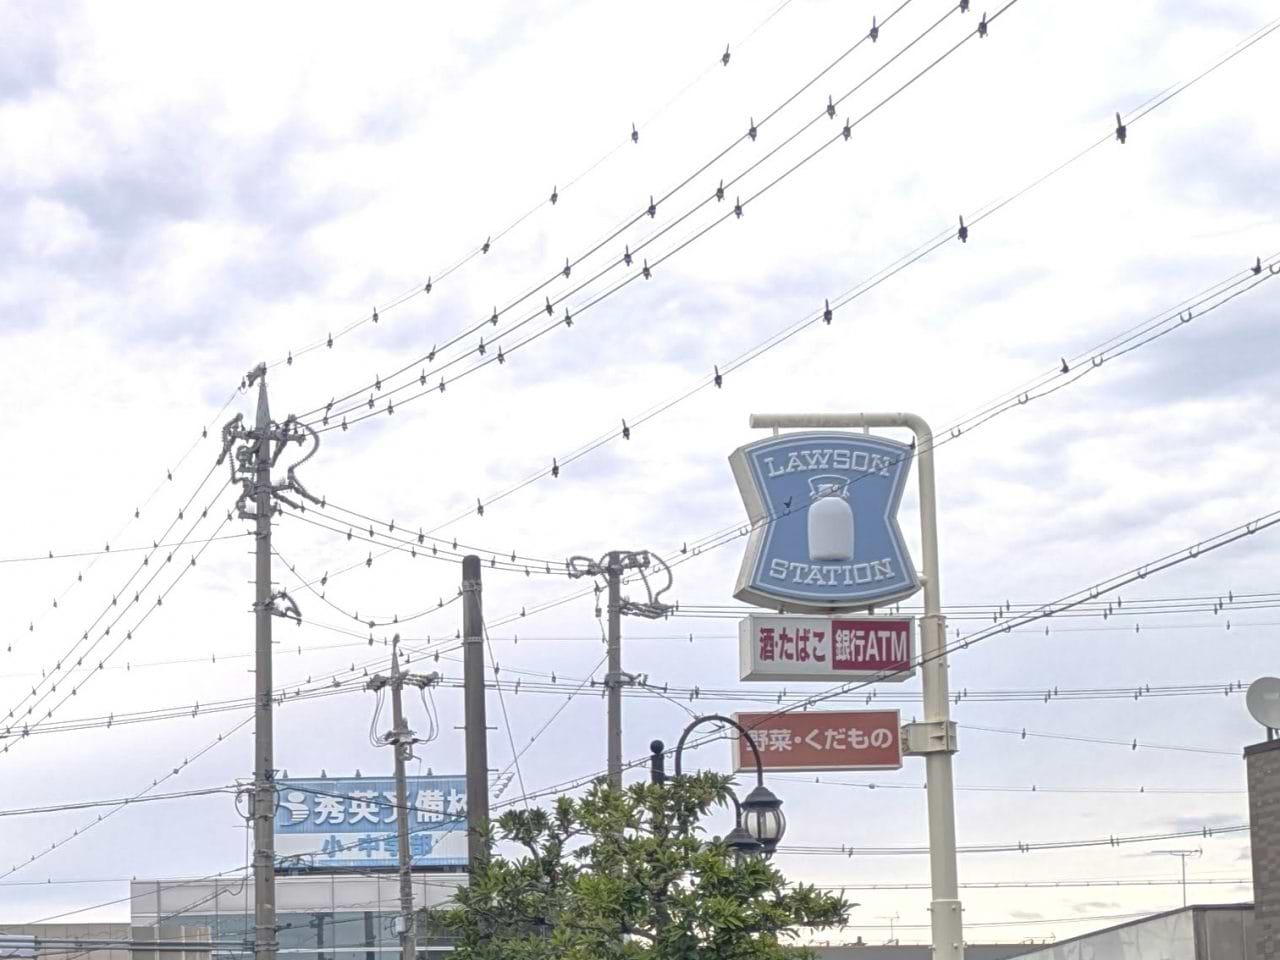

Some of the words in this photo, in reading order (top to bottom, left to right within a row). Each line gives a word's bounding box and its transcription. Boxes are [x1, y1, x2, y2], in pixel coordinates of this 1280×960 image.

[764, 450, 891, 478] LAWSON
[769, 558, 896, 586] STATION
[835, 629, 908, 662] 銀行ATM
